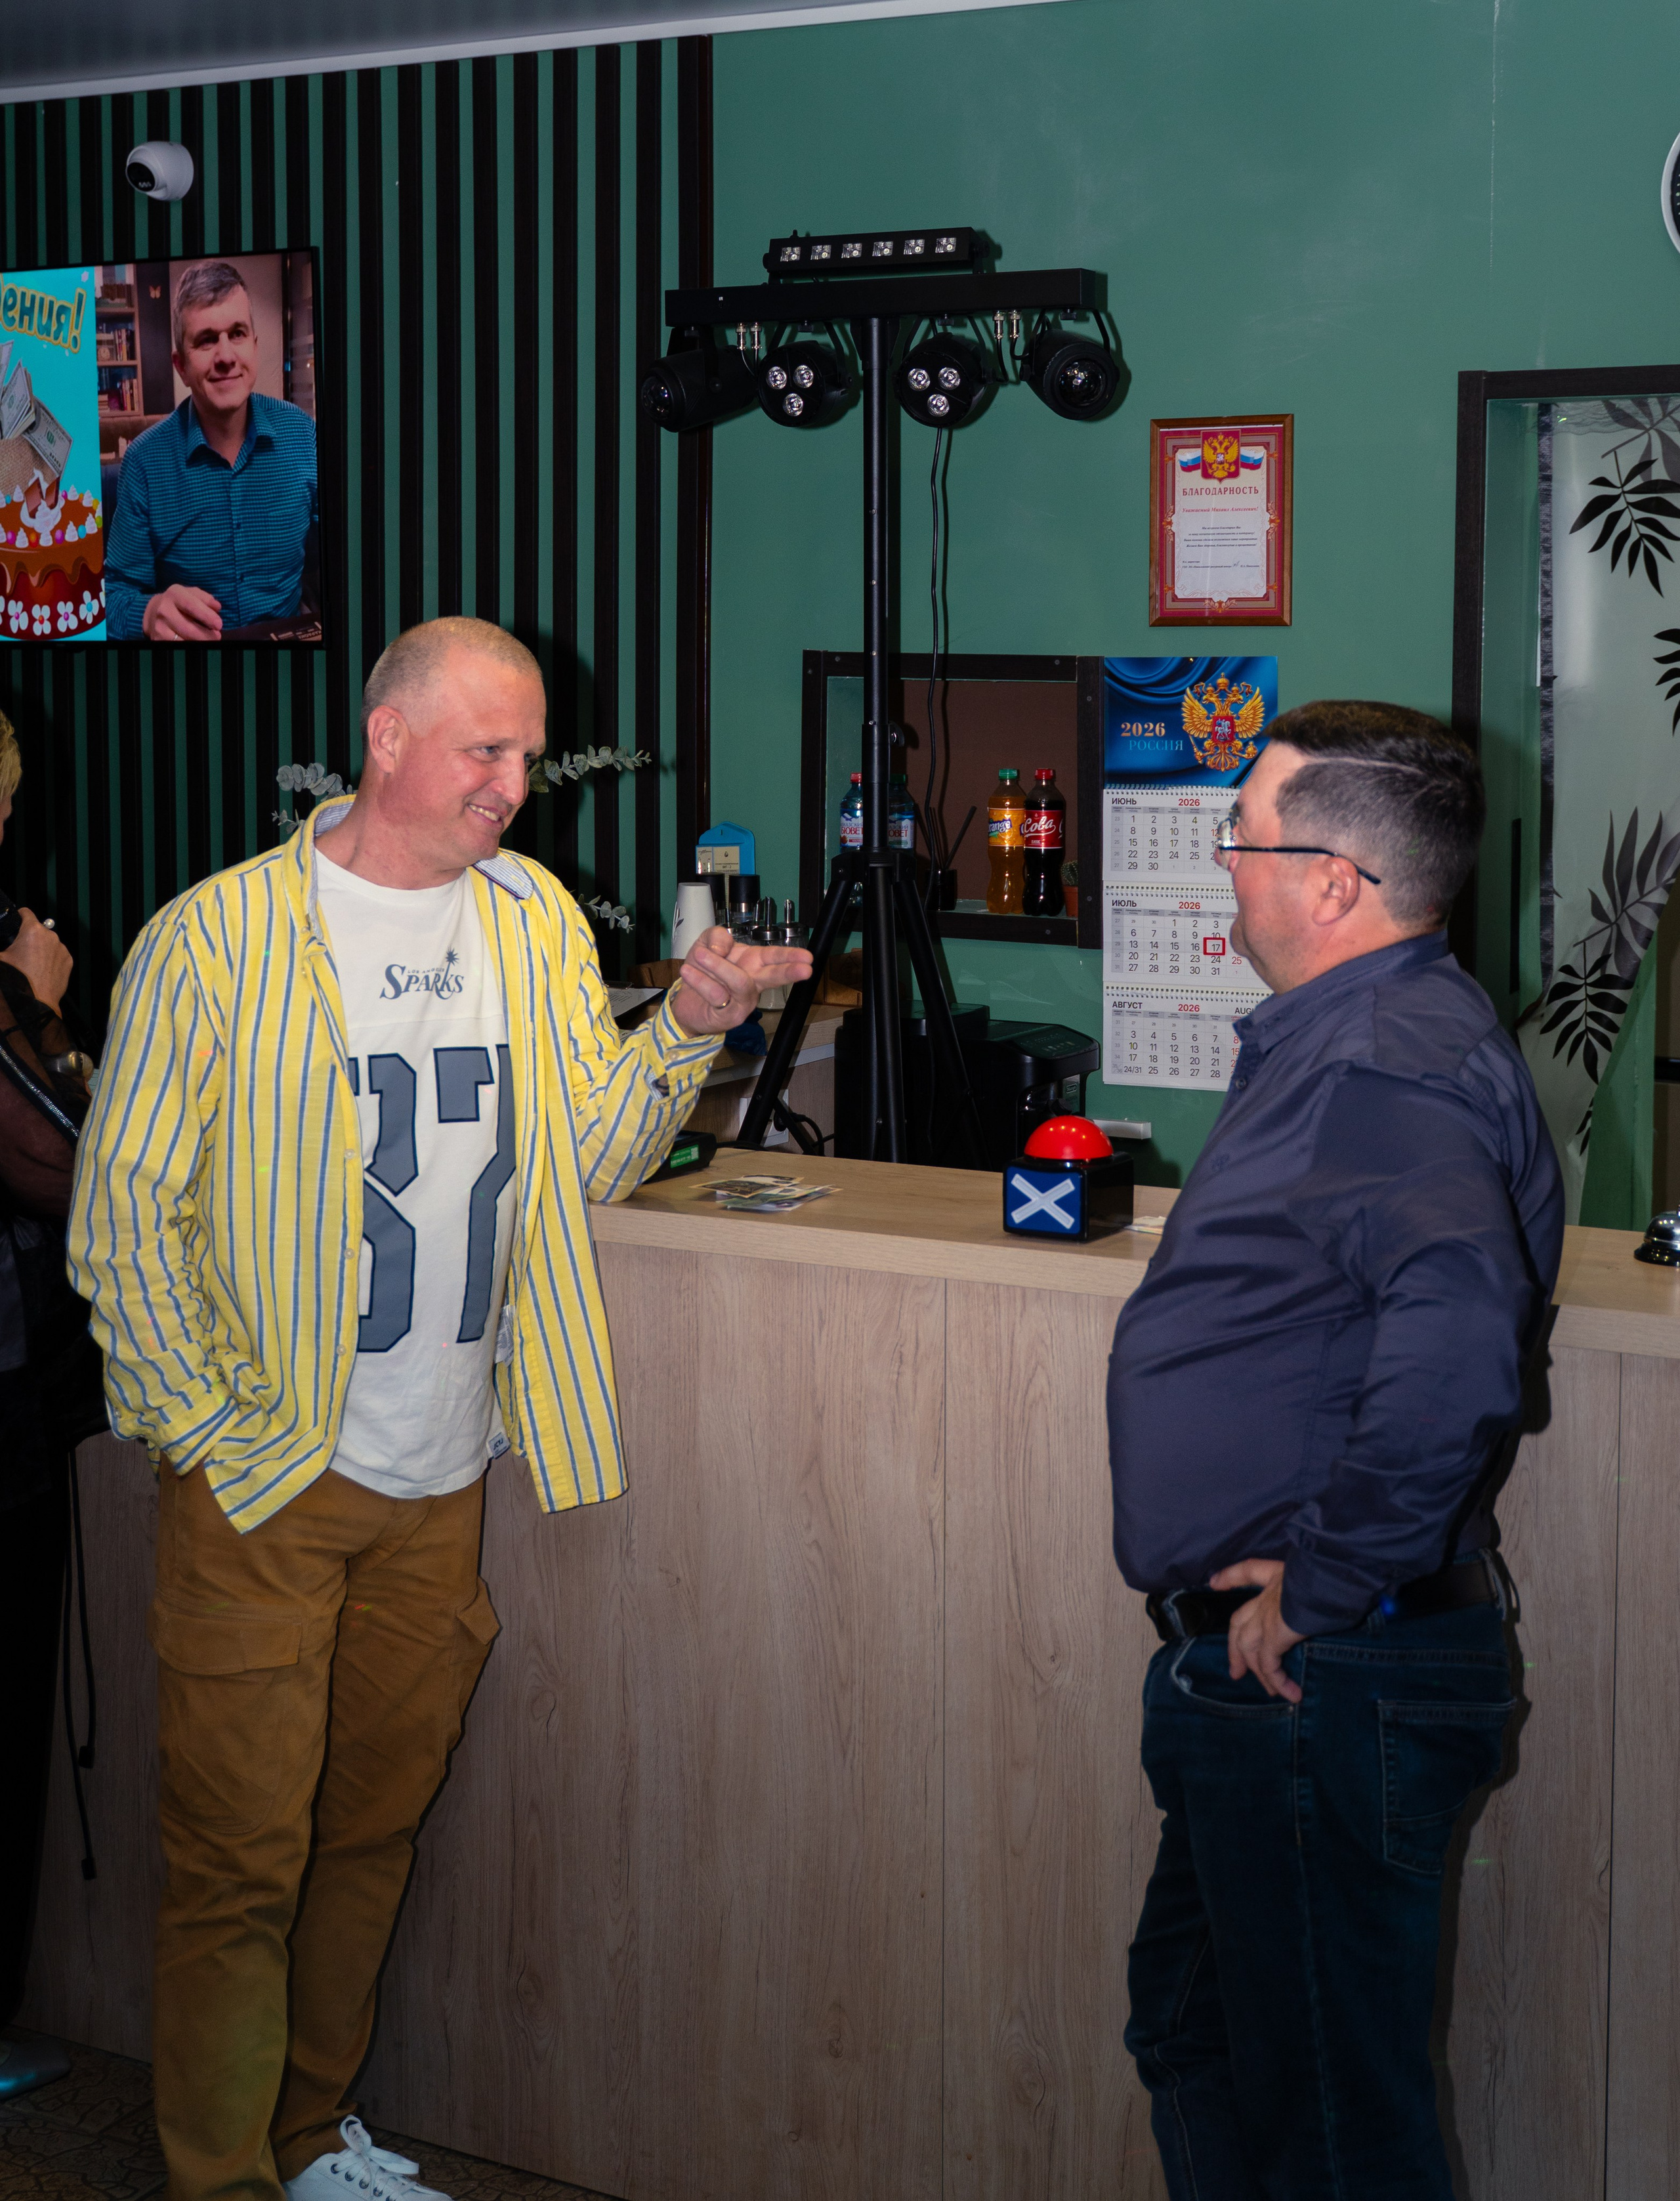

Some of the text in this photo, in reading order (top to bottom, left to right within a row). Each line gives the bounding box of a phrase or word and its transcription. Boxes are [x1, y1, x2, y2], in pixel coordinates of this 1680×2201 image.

[0, 284, 86, 353] ения!
[1182, 486, 1259, 496] БЛАГОДАРНОСТЬ
[1121, 722, 1166, 737] 2026
[1129, 740, 1183, 751] РОССИЯ
[1024, 816, 1056, 837] Cola
[379, 960, 464, 1000] SPARKS
